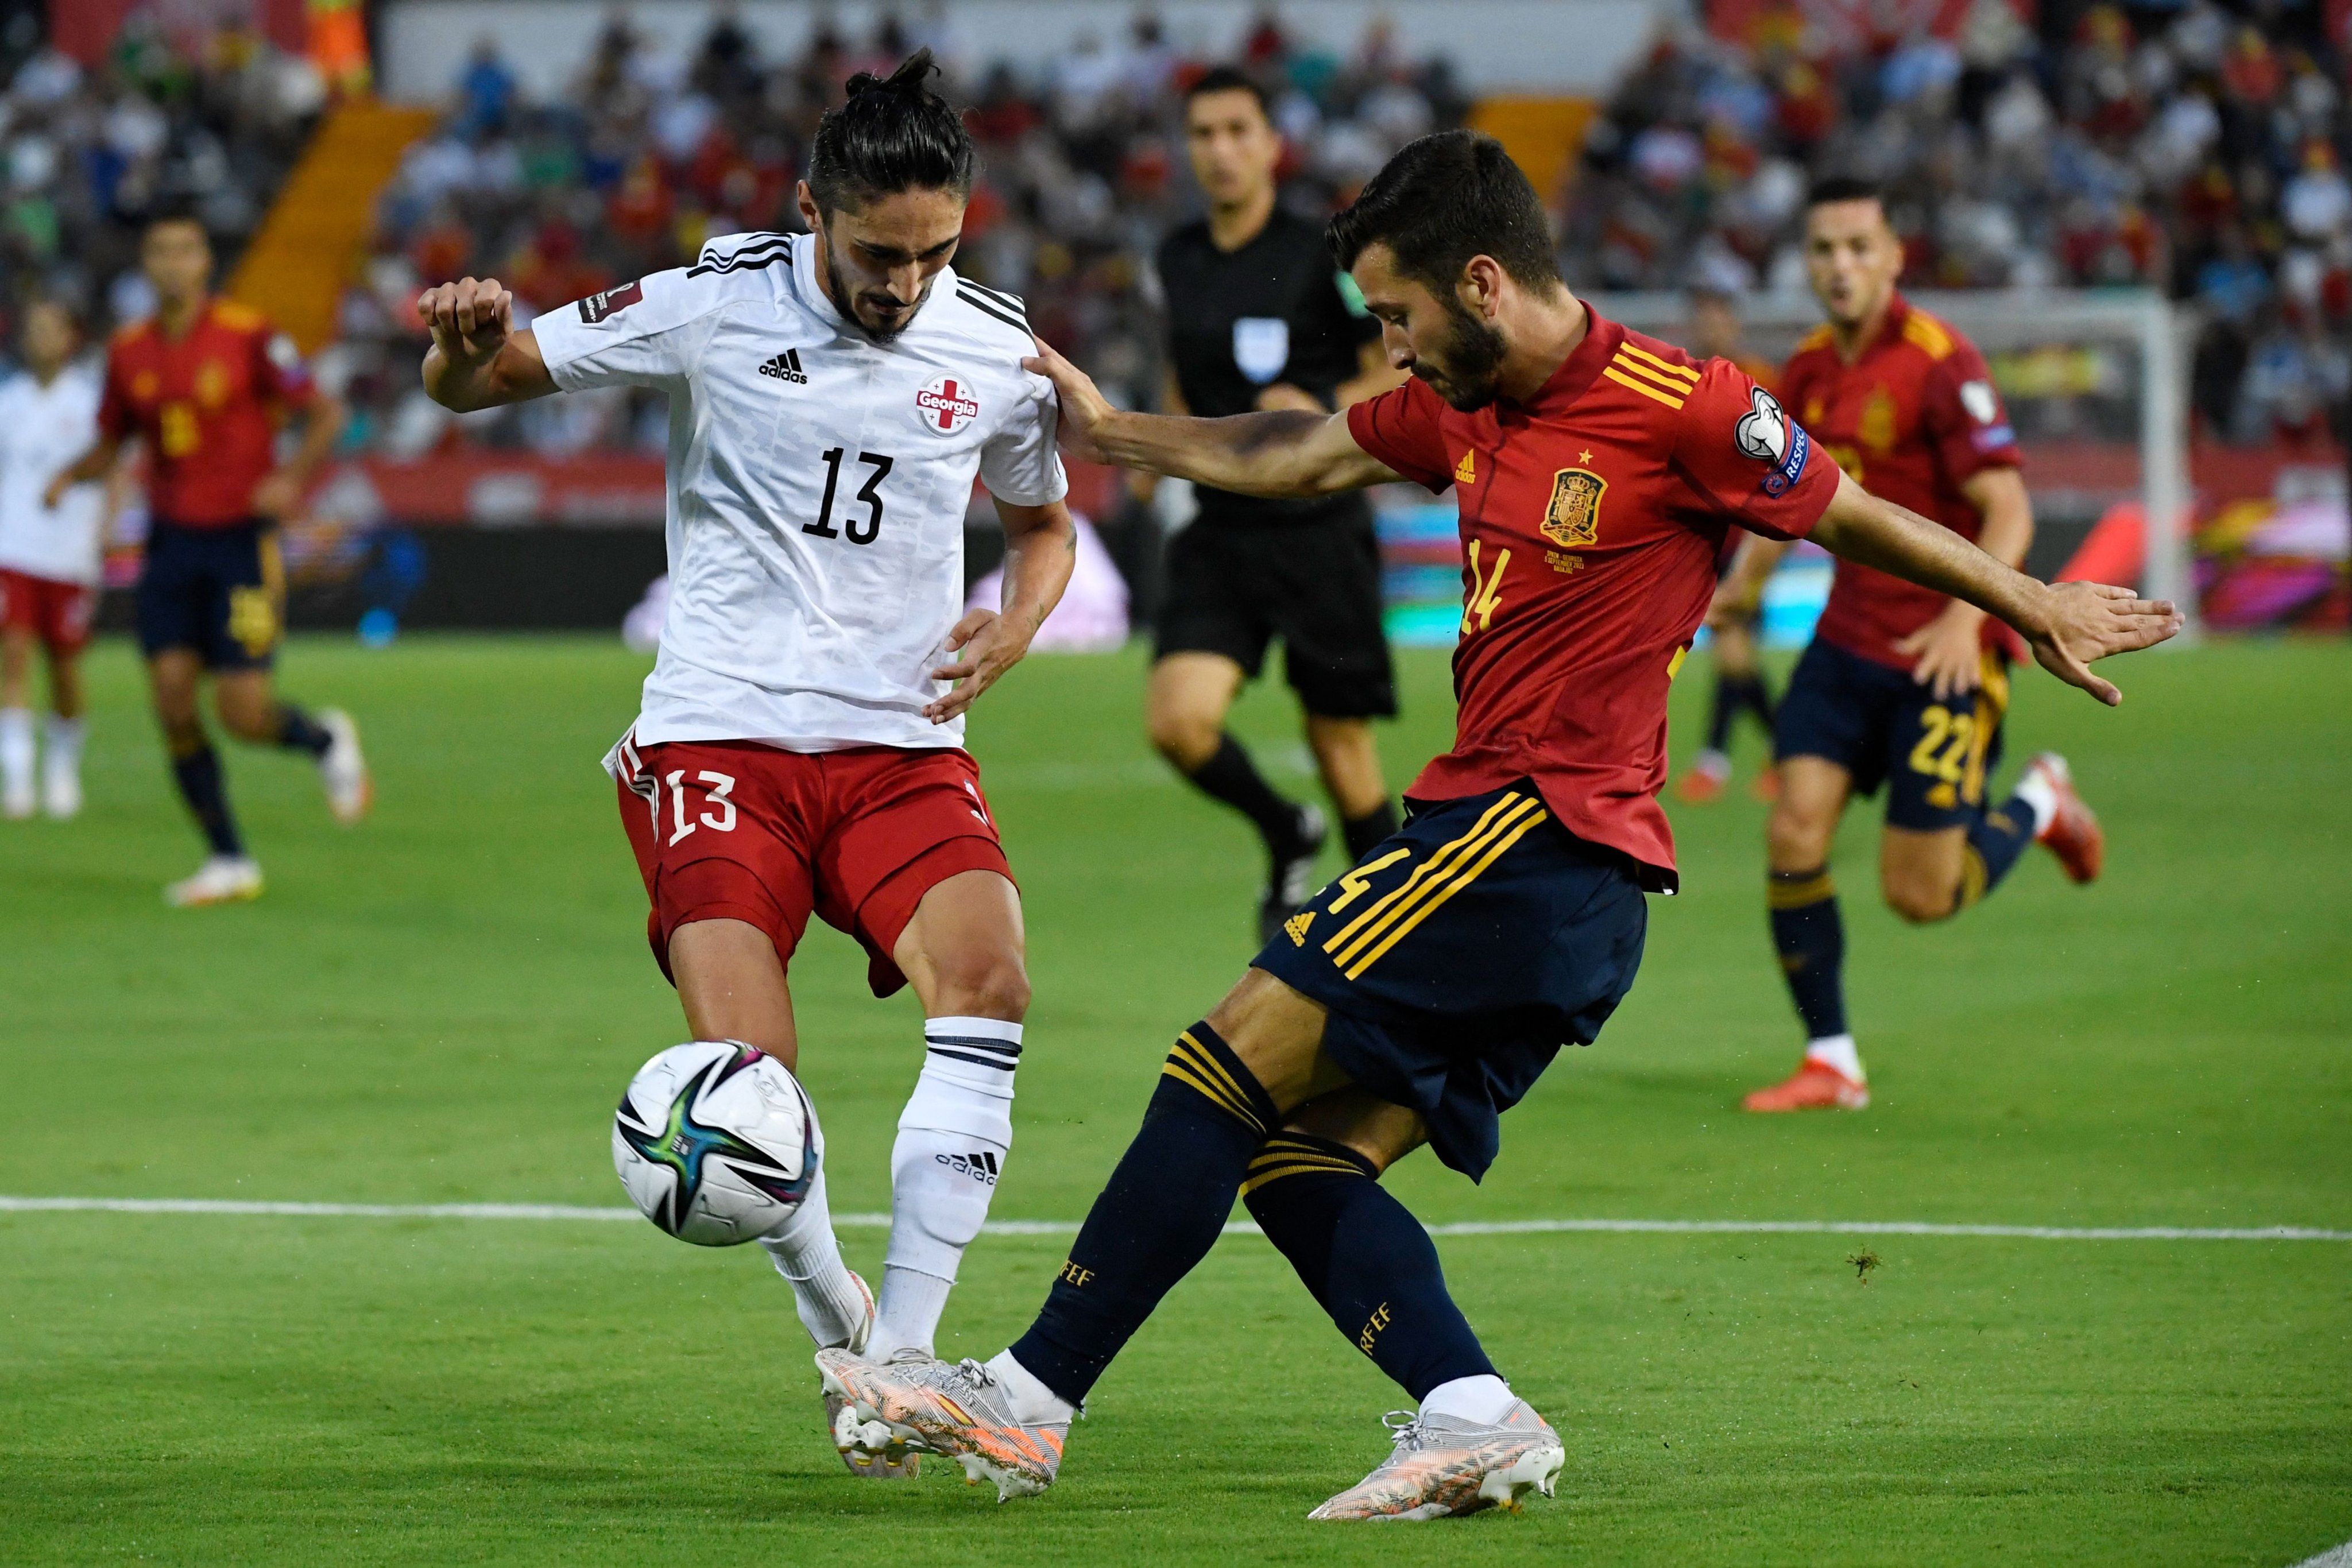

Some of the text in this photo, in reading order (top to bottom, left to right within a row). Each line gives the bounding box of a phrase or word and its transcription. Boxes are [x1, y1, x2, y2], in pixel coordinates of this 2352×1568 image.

[759, 365, 808, 385] adidas
[919, 392, 976, 416] Georgia
[802, 447, 894, 545] 13
[1455, 469, 1476, 484] adidas
[1461, 538, 1511, 636] 14
[1909, 704, 1973, 782] 22
[666, 769, 737, 847] 13
[1314, 847, 1411, 915] 4
[1284, 919, 1305, 947] adidas
[935, 1154, 997, 1186] adida
[1059, 1260, 1095, 1286] FEF
[1360, 1302, 1390, 1357] RFEF
